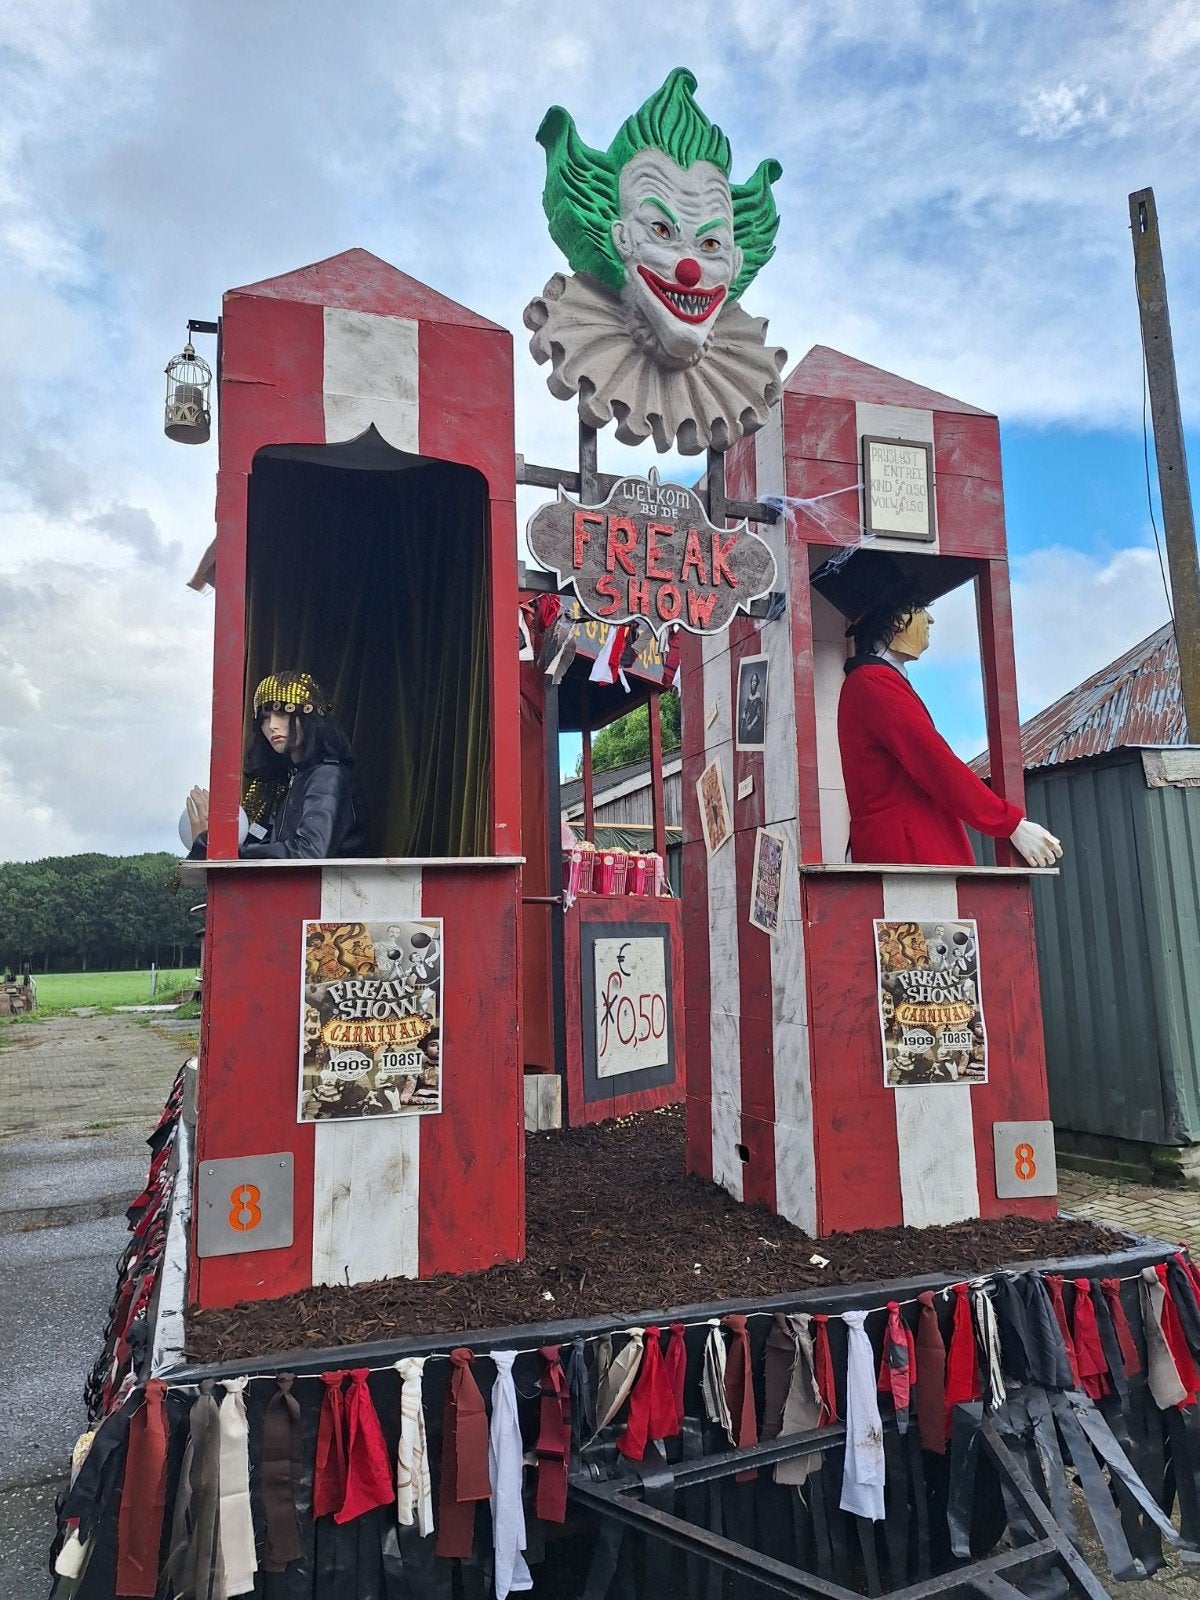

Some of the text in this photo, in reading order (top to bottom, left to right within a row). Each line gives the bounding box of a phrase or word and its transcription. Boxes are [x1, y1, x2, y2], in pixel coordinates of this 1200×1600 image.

[883, 464, 925, 480] ENTREE
[623, 482, 690, 510] WELKOM
[871, 479, 893, 493] KIND
[640, 502, 678, 519] BY DE
[572, 510, 739, 588] FREAK
[596, 574, 718, 628] SHOW
[897, 969, 960, 990] FREAK
[327, 977, 416, 1004] FREAK
[906, 985, 963, 1004] SHOW
[338, 995, 418, 1021] SHOW
[901, 1005, 970, 1023] CARNIVAL
[330, 1021, 422, 1043] CARNIVAL
[903, 1036, 935, 1046] 1909
[330, 1059, 371, 1072] 1909
[1014, 1143, 1036, 1180] 8
[228, 1184, 262, 1232] 8
